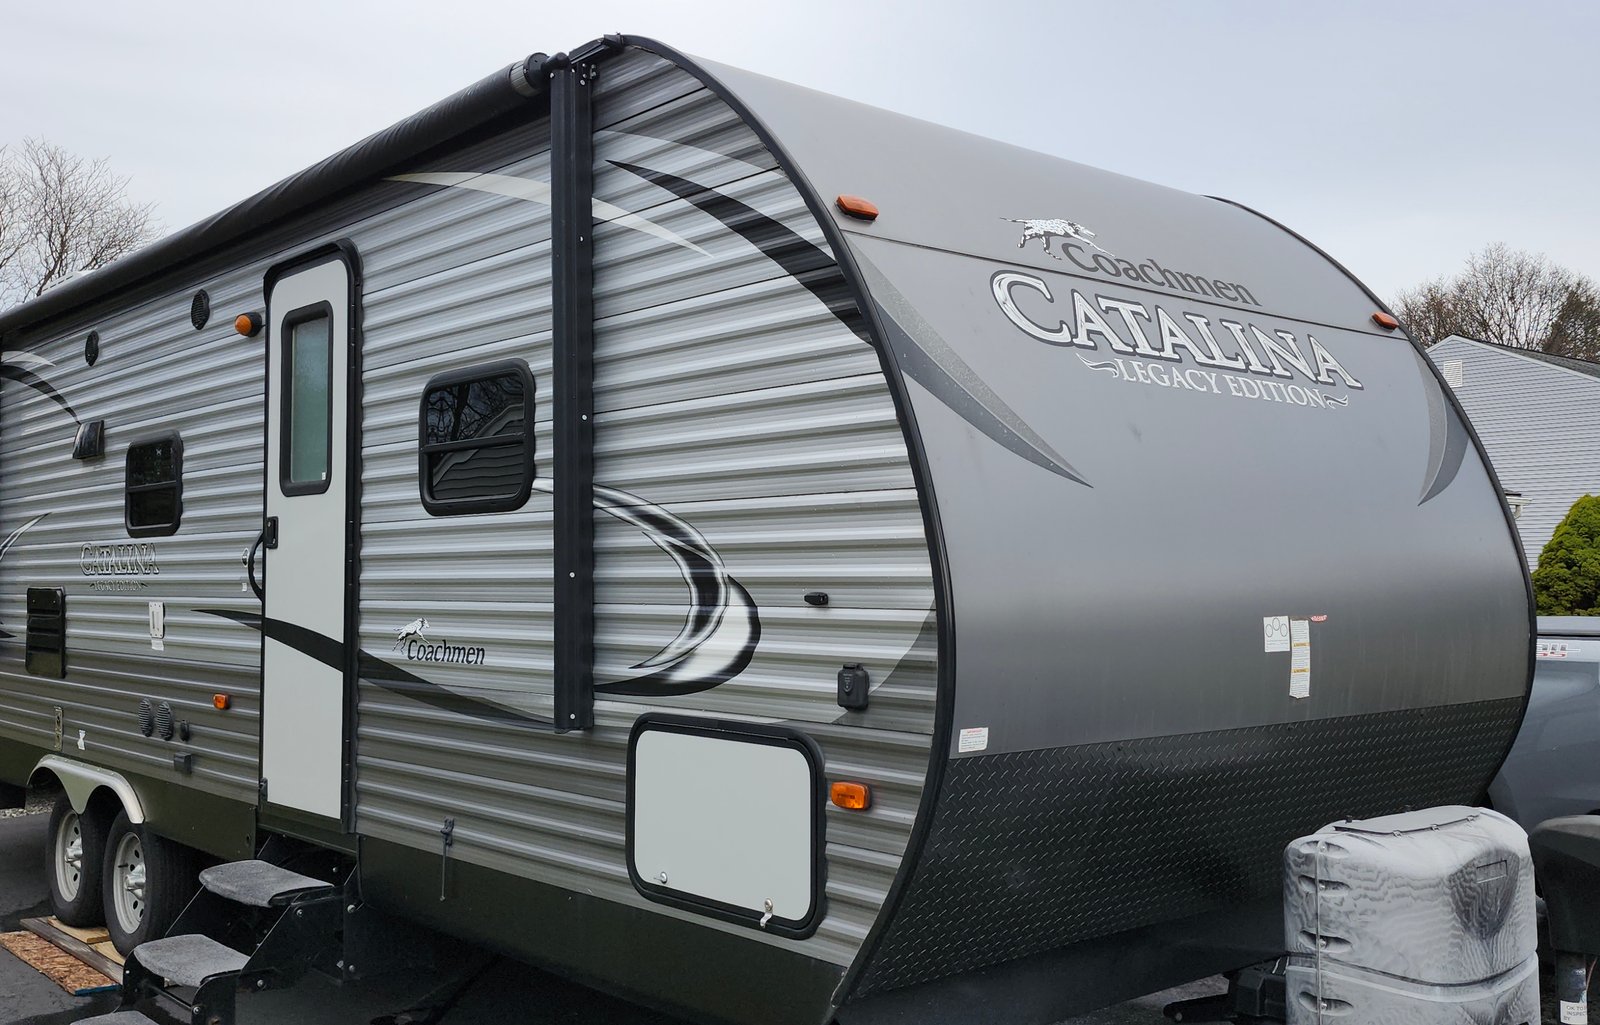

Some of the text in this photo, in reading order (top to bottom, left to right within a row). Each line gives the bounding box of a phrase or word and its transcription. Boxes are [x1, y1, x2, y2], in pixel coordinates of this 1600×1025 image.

[1061, 242, 1263, 307] Coachmen
[990, 270, 1364, 391] CATALINA
[1116, 357, 1329, 409] LEGACY EDITION
[80, 543, 160, 576] CATALINA
[407, 639, 486, 665] Coachmen
